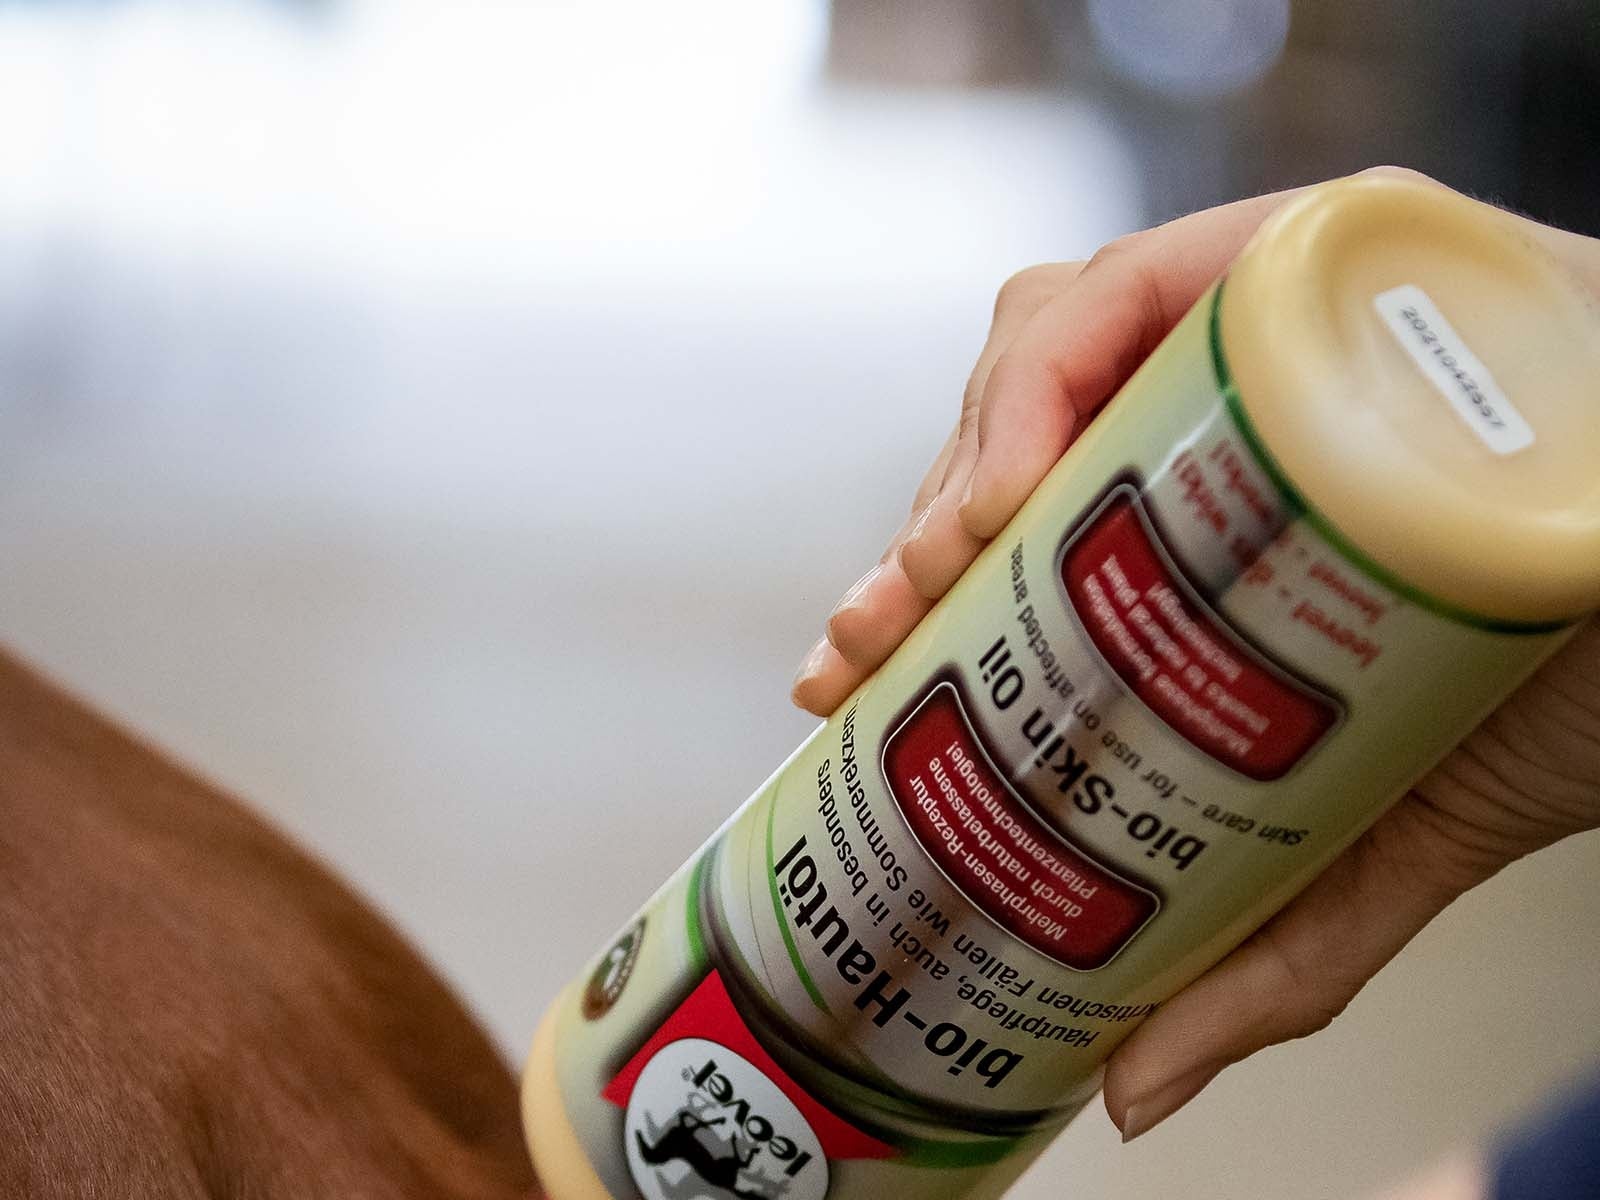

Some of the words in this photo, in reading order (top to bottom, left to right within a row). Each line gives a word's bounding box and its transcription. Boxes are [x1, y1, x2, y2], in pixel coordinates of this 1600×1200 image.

[975, 634, 1025, 711] Oil
[1016, 603, 1075, 699] affected
[1071, 698, 1103, 731] on
[1101, 729, 1142, 769] use
[1018, 707, 1208, 871] bio-Skin
[1140, 766, 1177, 797] for
[813, 757, 868, 896] besonders
[929, 755, 1031, 881] naturbelassene
[944, 739, 1098, 899] Pflanzentechnologie!
[1200, 803, 1256, 832] care
[908, 774, 1067, 940] Mehrphasen-Rezeptur
[864, 892, 890, 926] in
[907, 887, 950, 936] wie
[1026, 876, 1083, 919] durch
[770, 833, 1024, 1087] bio-Hautöl
[889, 922, 950, 980] auch
[951, 932, 1034, 997] Fällen
[954, 973, 1100, 1047] Hautpflege,
